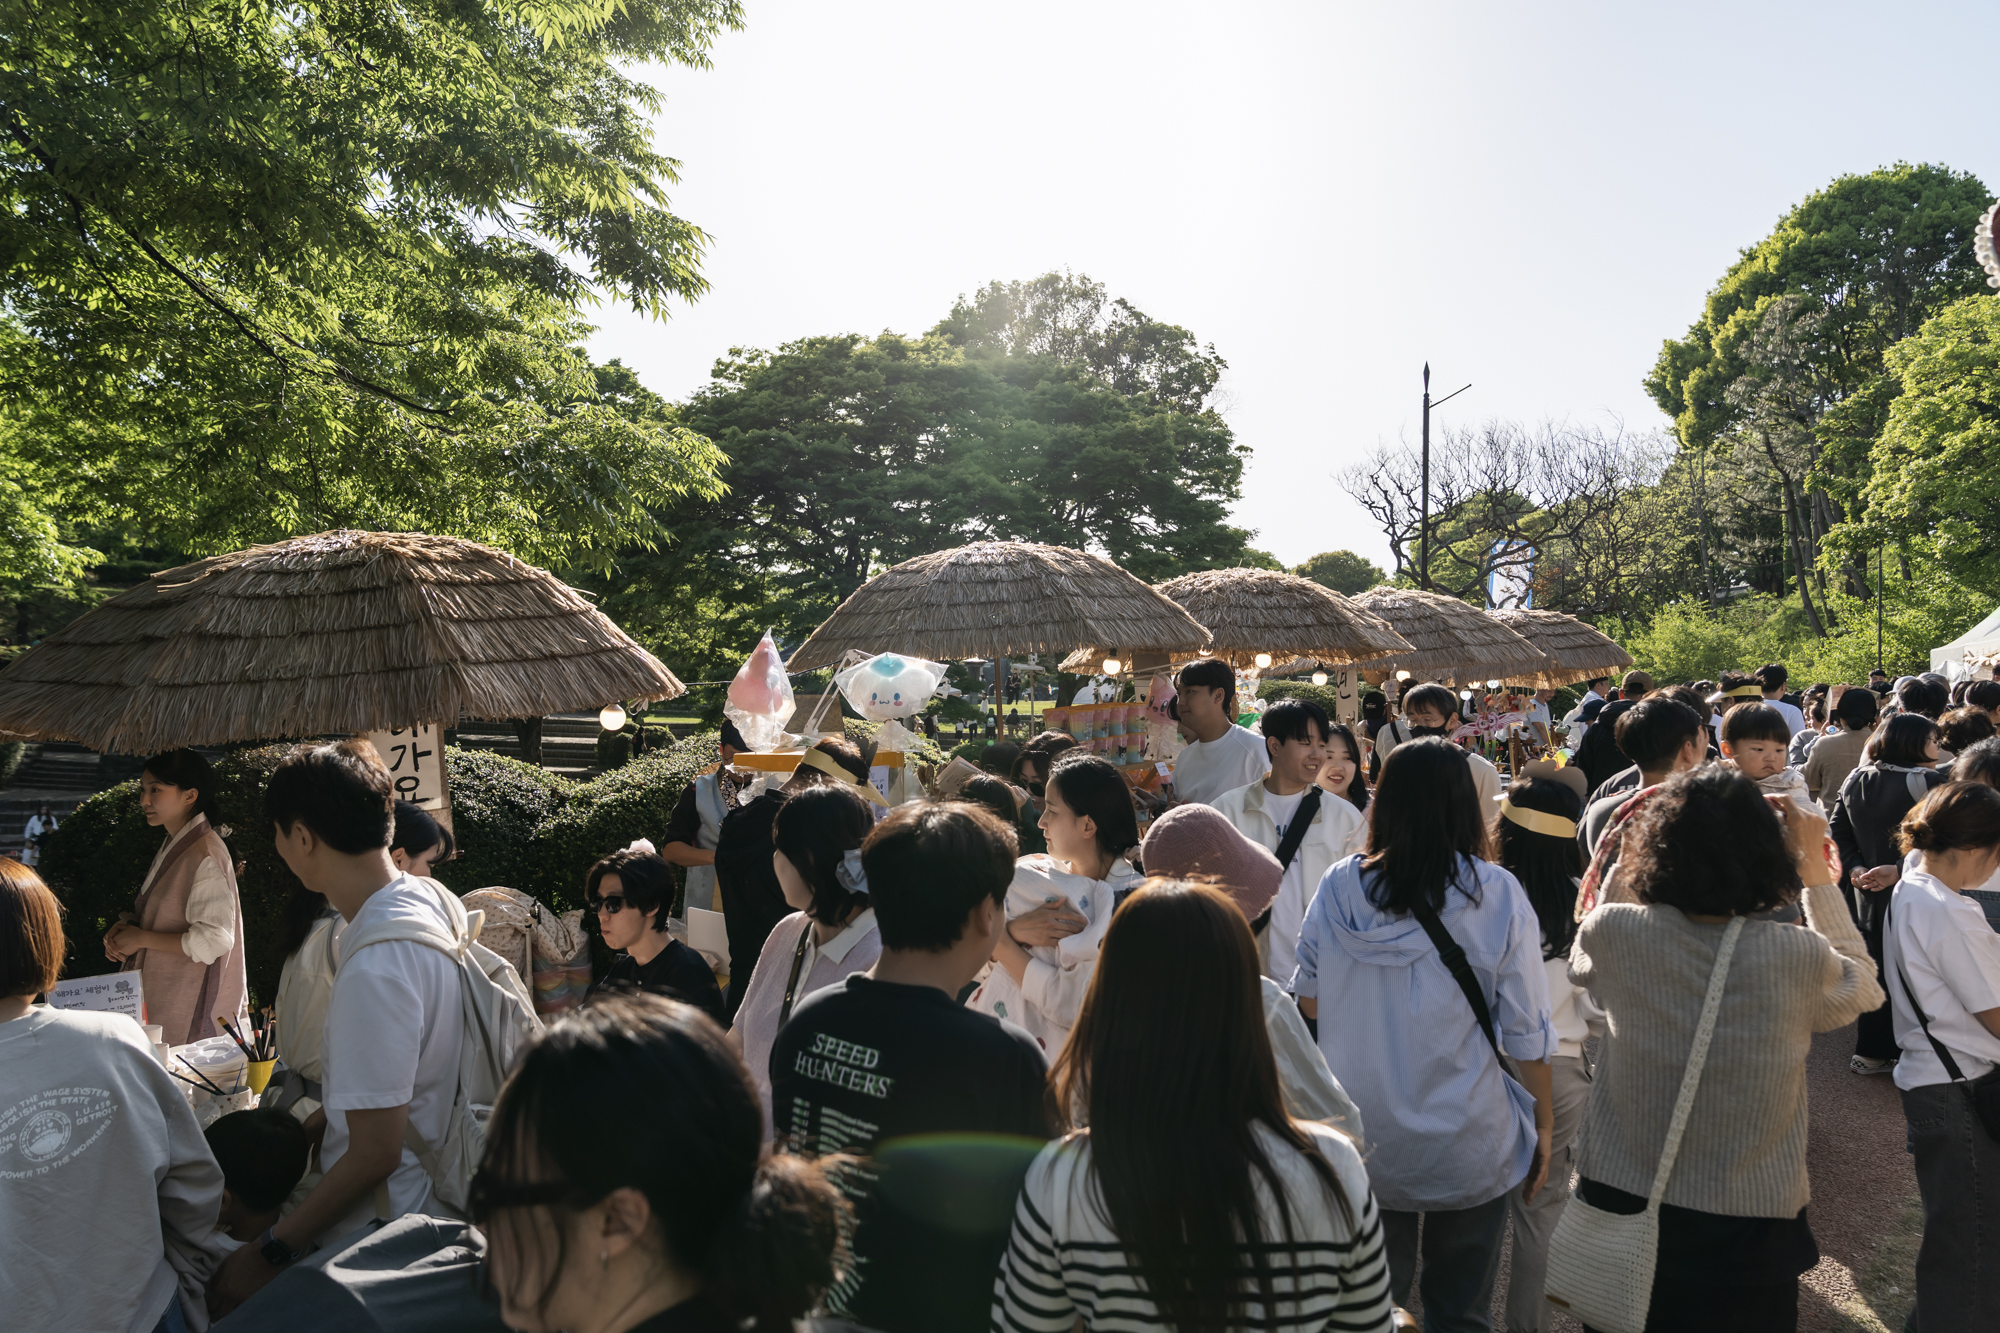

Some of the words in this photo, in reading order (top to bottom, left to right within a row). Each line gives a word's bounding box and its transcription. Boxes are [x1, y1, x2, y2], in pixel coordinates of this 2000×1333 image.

[85, 984, 109, 995] 체험비
[812, 1033, 880, 1069] SPEED
[795, 1050, 891, 1098] HUNTERS
[0, 1105, 17, 1123] ISH
[19, 1094, 38, 1108] THE
[42, 1088, 71, 1098] WAGE
[73, 1087, 111, 1098] SYSTEM
[38, 1099, 57, 1109] THE
[60, 1096, 91, 1105] STATE
[76, 1105, 119, 1126] DETROIT
[0, 1169, 34, 1179] POWER
[36, 1165, 49, 1176] TO
[52, 1154, 71, 1170] THE
